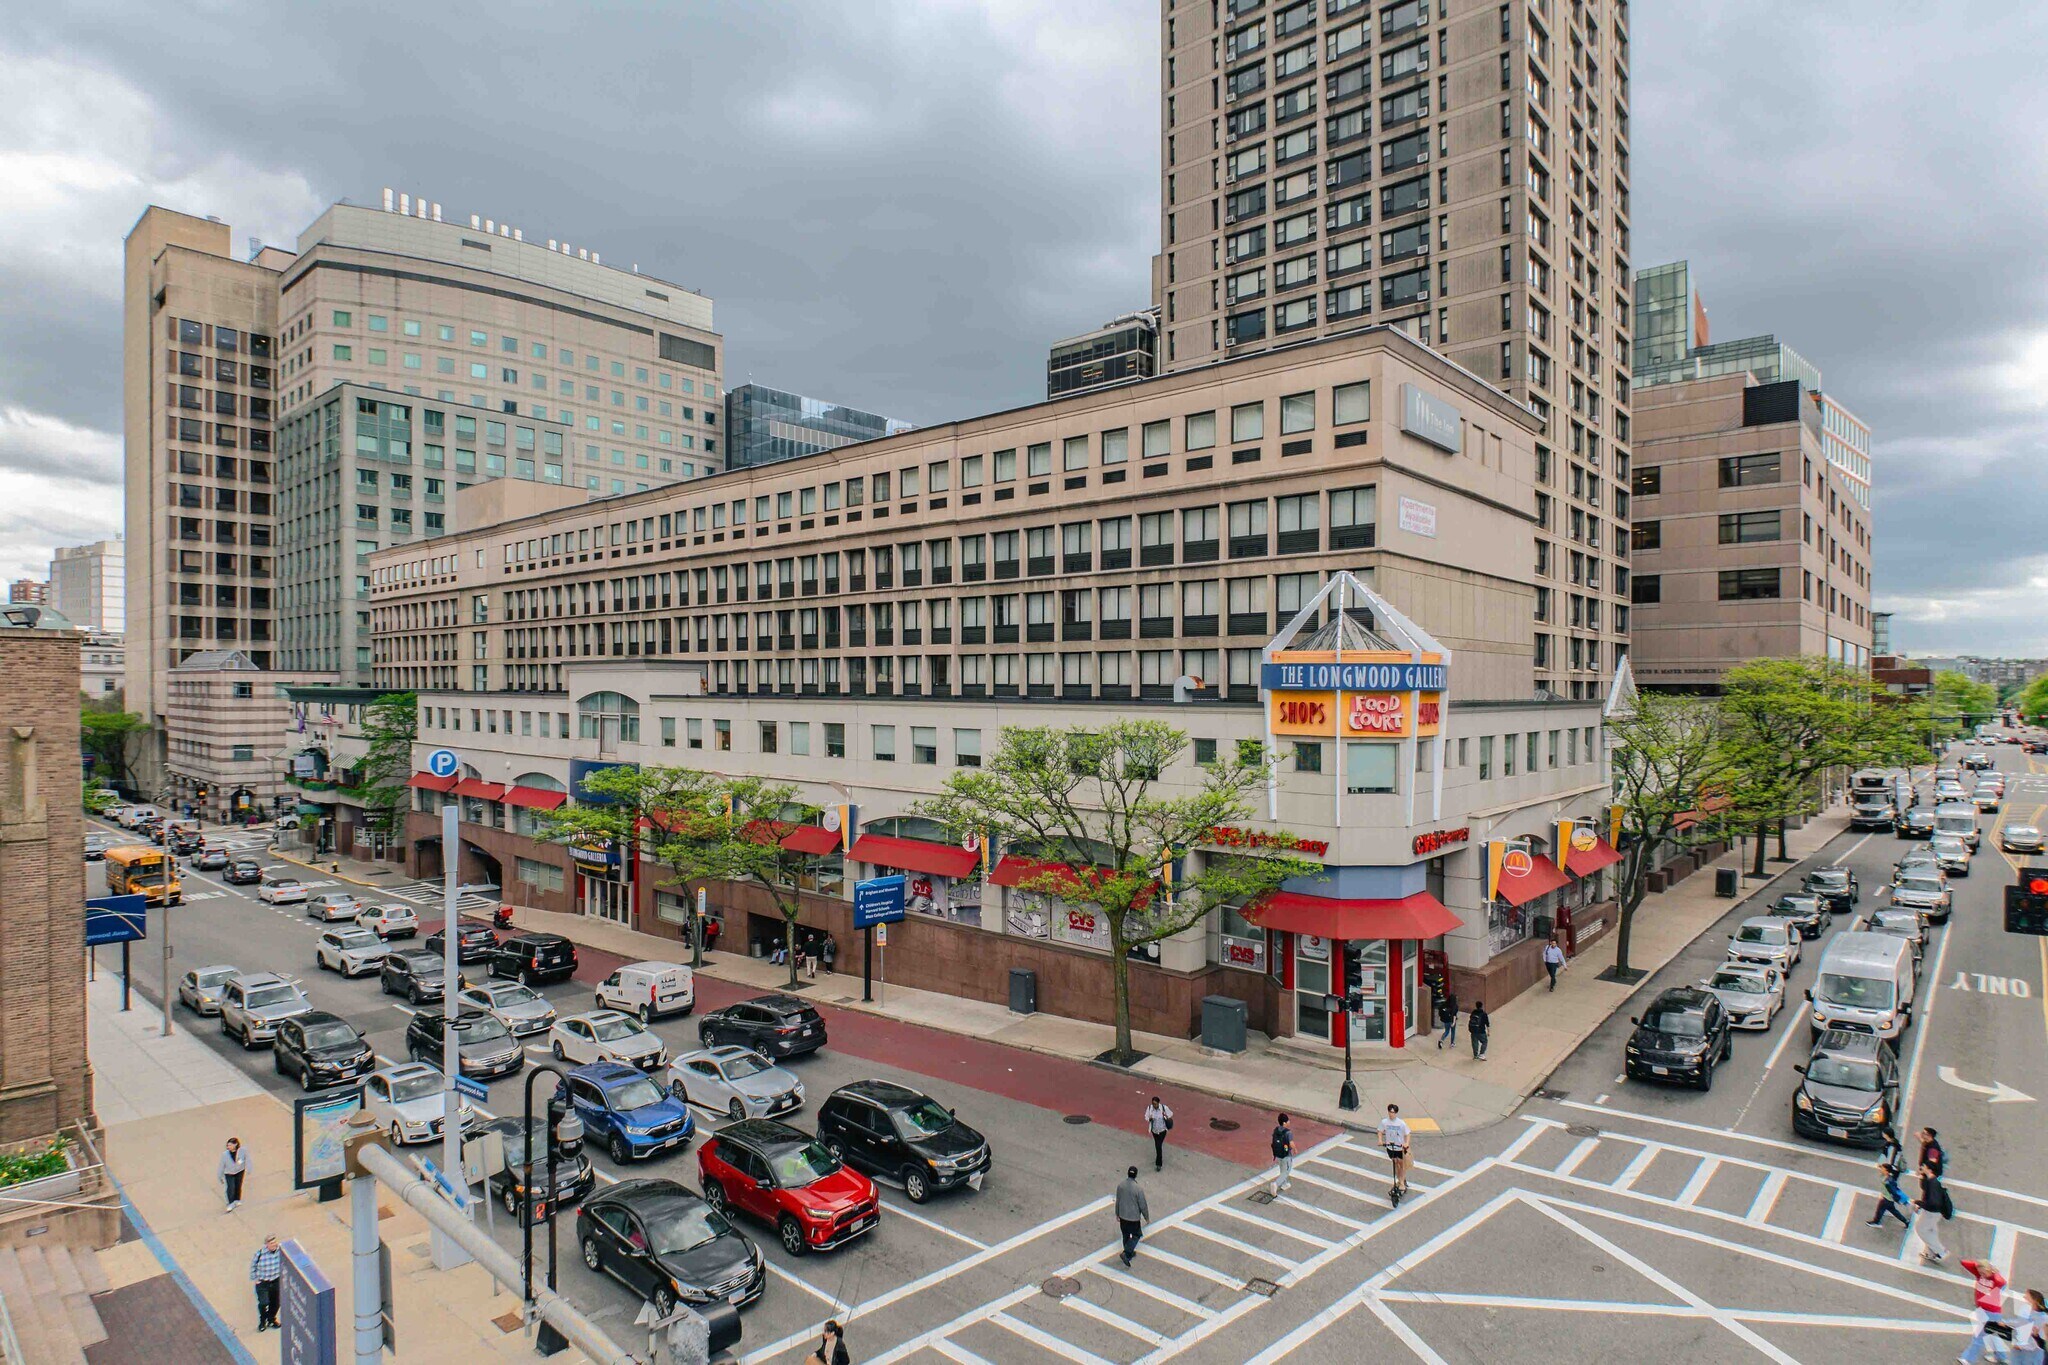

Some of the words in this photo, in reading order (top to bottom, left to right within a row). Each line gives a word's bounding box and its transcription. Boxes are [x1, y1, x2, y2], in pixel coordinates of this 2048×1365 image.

[1281, 666, 1303, 683] THE
[1309, 666, 1400, 687] LONGWOOD
[1280, 701, 1326, 724] SHOPS
[1355, 695, 1400, 713] FOOD
[1349, 711, 1404, 731] COURT
[437, 754, 453, 773] P
[912, 879, 933, 895] CVS
[1068, 910, 1095, 927] CVS
[1229, 945, 1255, 959] CVS
